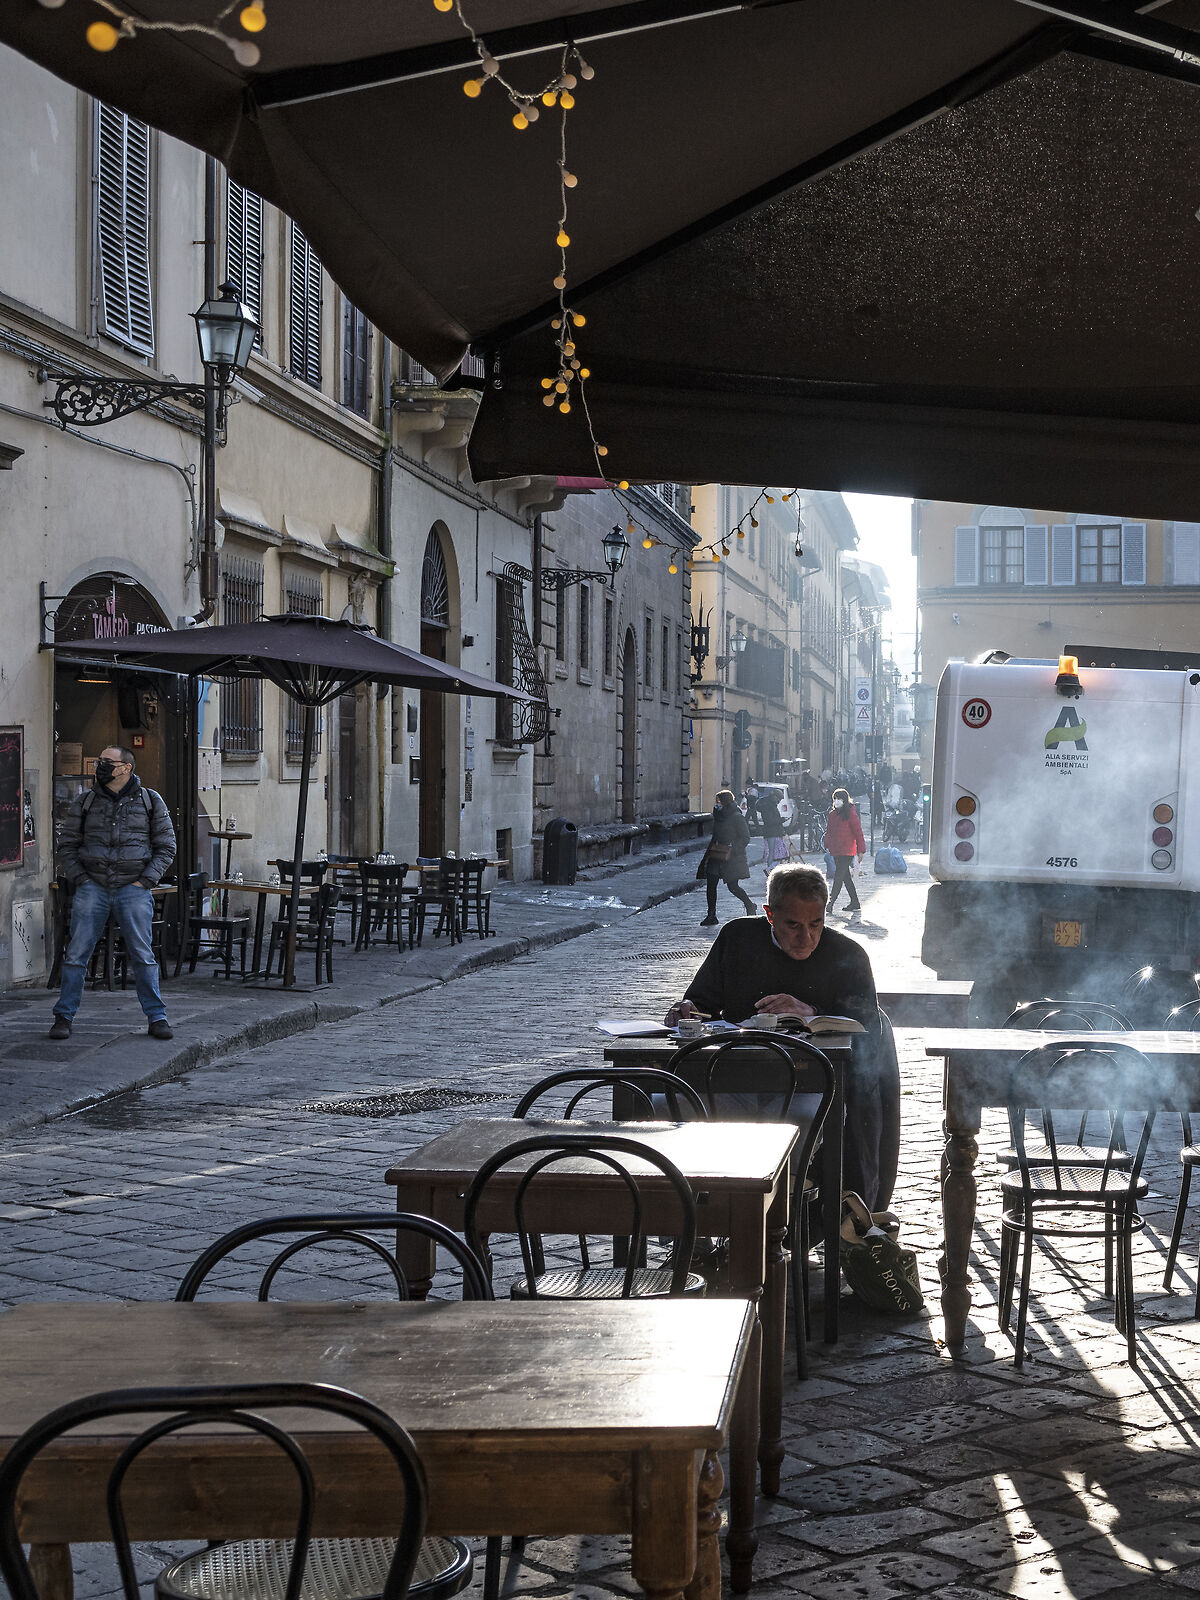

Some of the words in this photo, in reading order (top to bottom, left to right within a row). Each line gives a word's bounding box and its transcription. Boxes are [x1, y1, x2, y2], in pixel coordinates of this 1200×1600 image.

[969, 705, 985, 718] 40
[1045, 761, 1089, 769] AMBIENTALI
[1046, 856, 1078, 868] 4576
